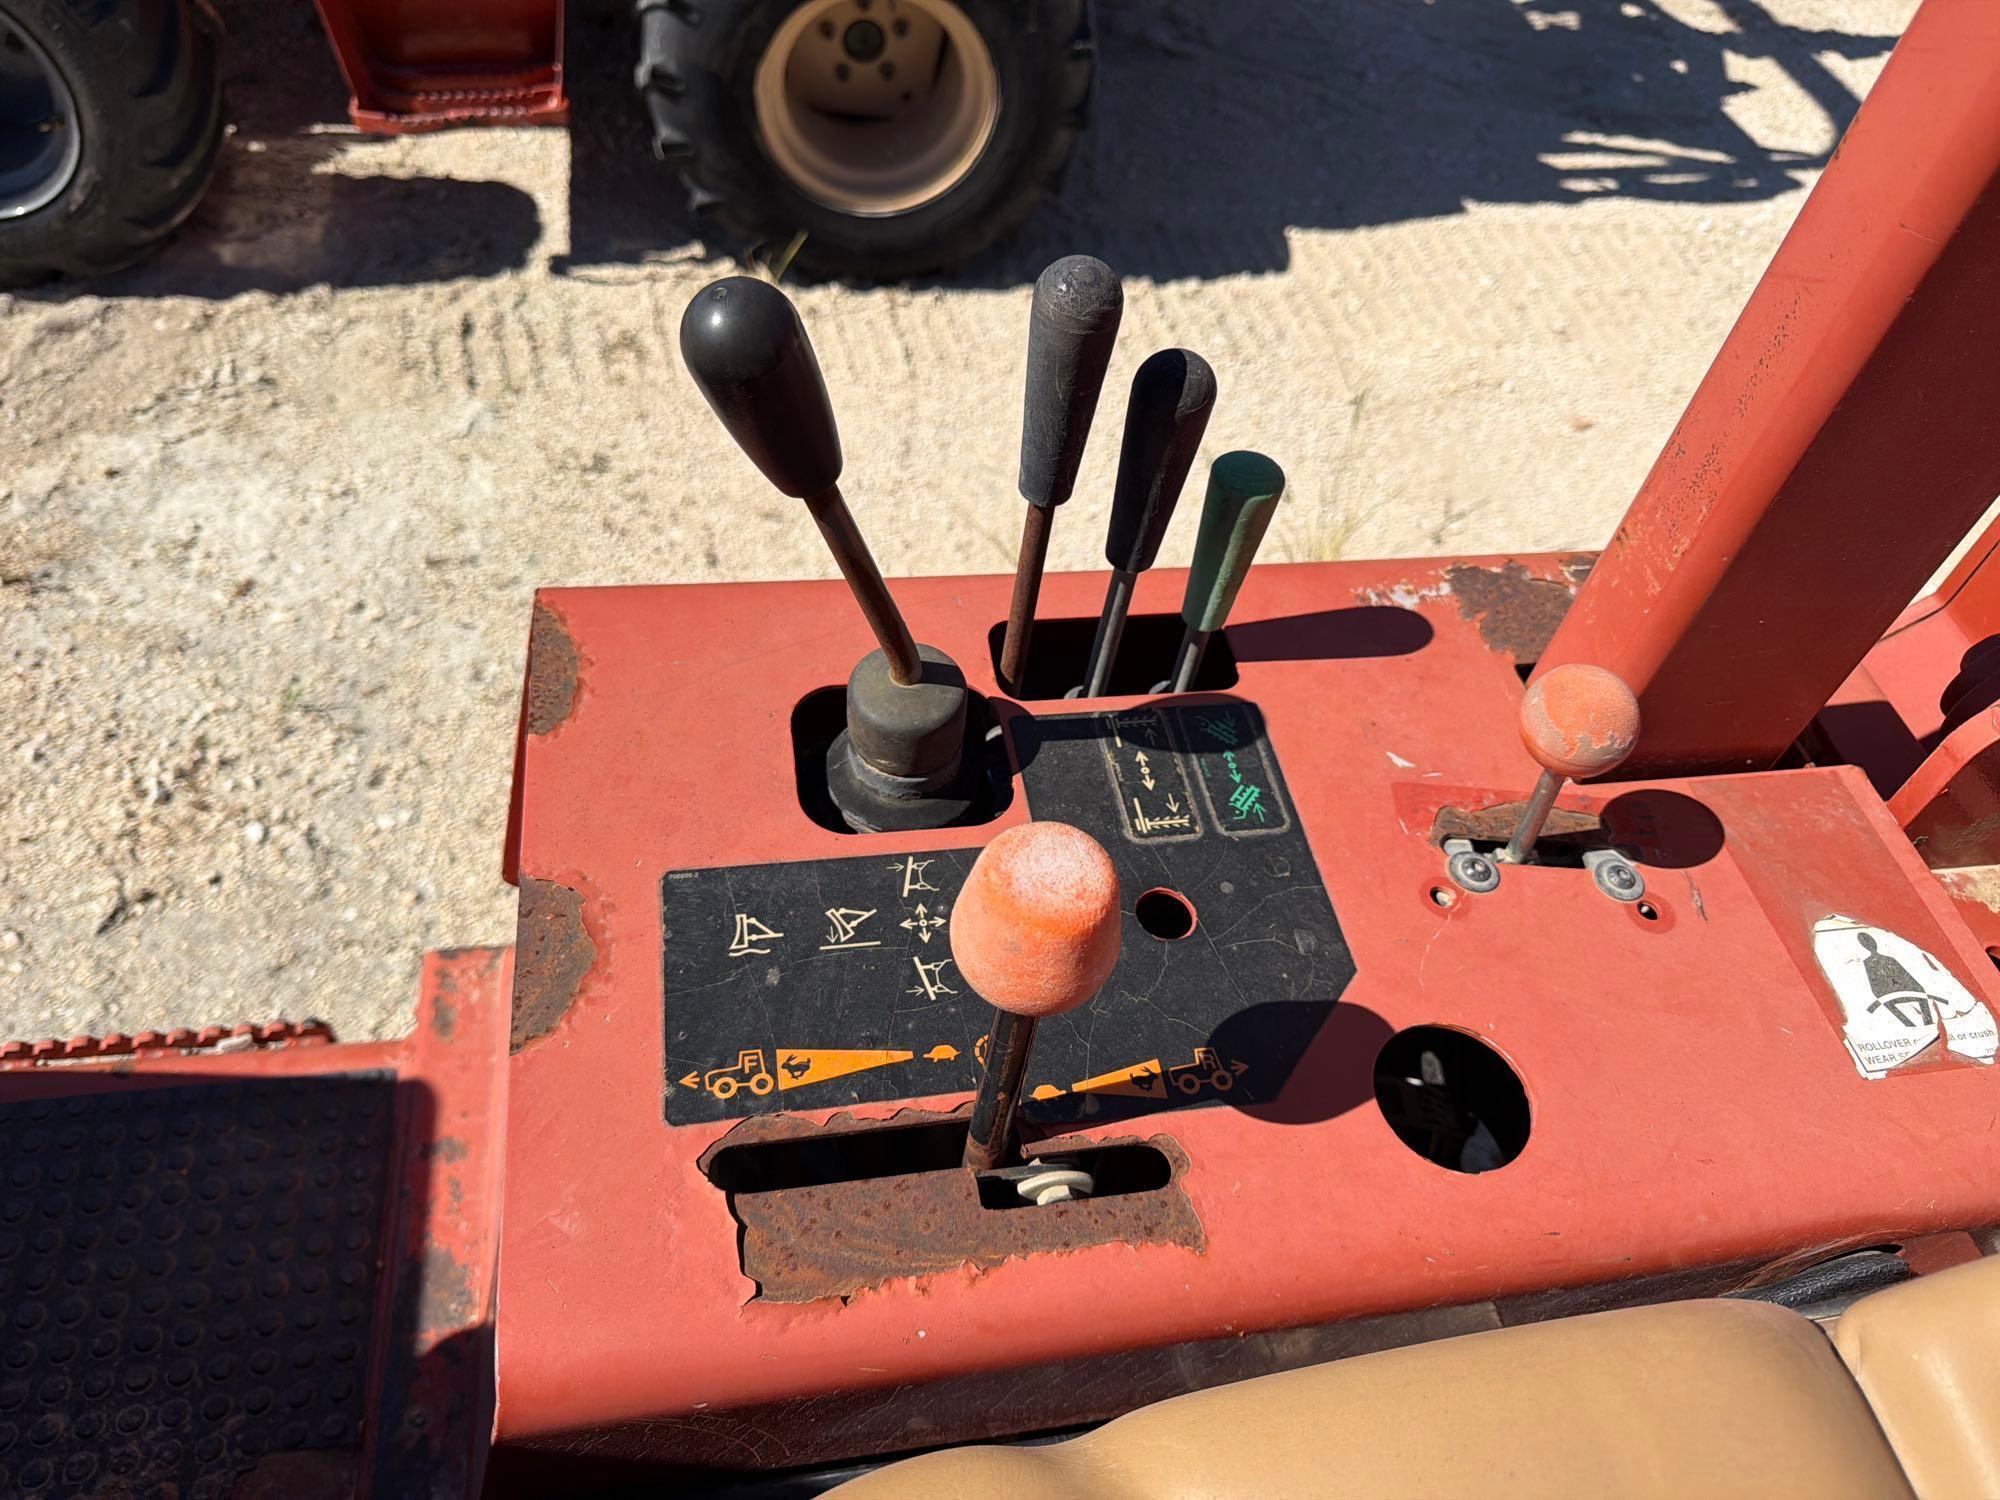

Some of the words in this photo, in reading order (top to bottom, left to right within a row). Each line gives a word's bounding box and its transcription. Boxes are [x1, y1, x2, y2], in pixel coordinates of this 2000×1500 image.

[1858, 1038, 1912, 1052] ROLLOVER
[1957, 1032, 1967, 1041] or
[1969, 1029, 1995, 1040] crush
[744, 1055, 758, 1073] F
[1200, 1053, 1217, 1070] R
[1865, 1053, 1897, 1065] WEAR
